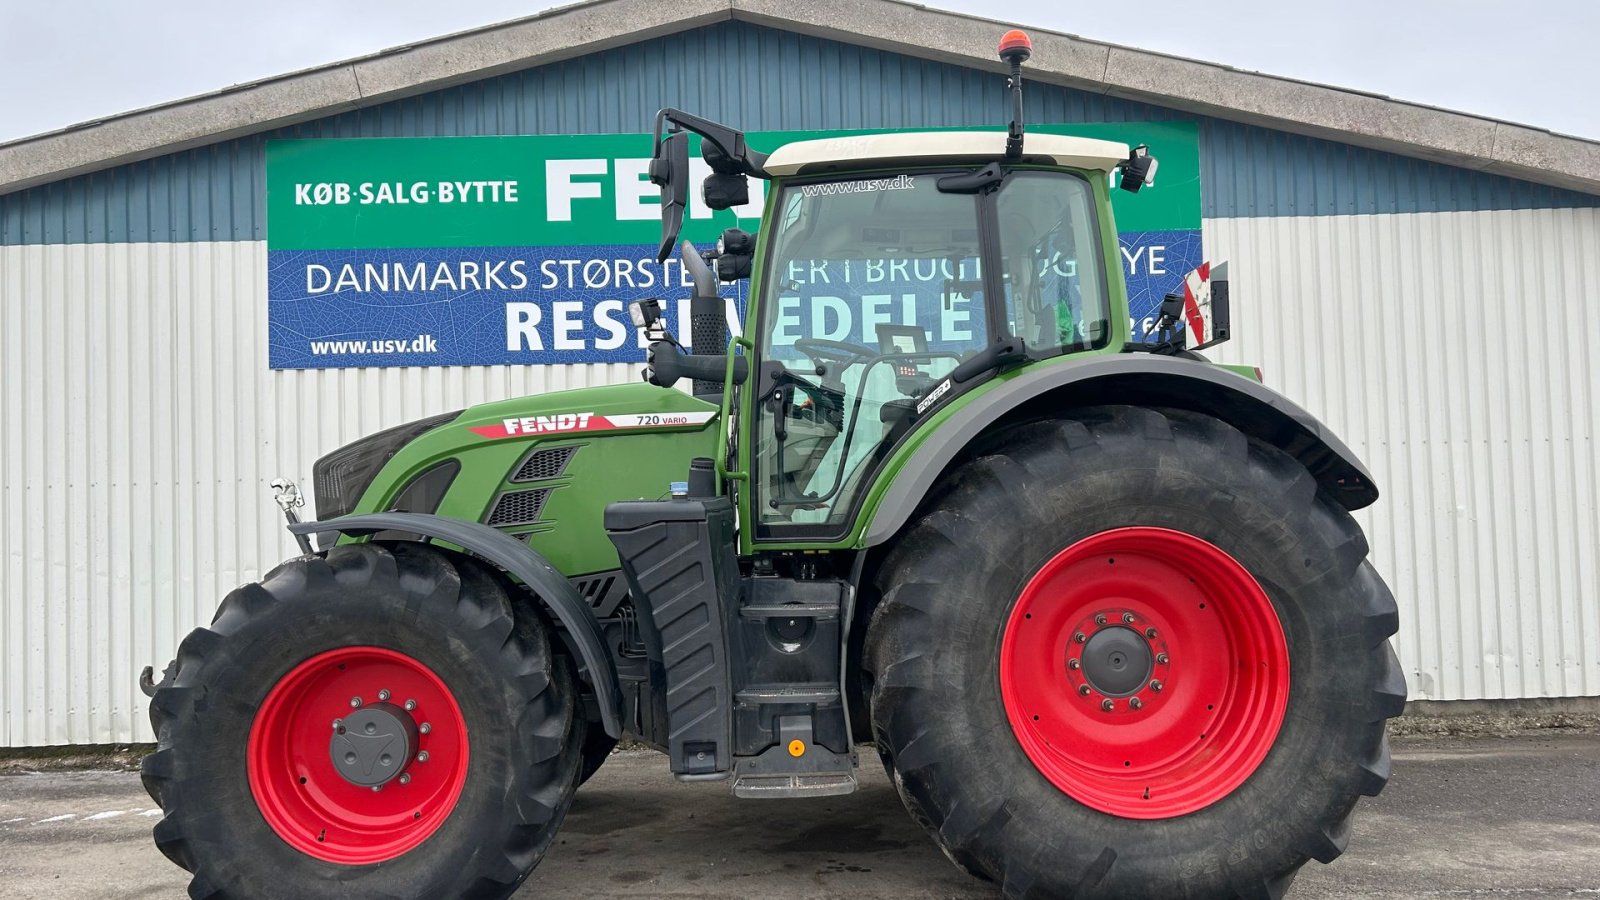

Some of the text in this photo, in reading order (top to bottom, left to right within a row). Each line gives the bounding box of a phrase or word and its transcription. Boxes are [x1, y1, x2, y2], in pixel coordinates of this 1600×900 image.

[801, 174, 915, 198] www.usv.dk
[306, 260, 528, 294] DANMARKS
[1120, 245, 1167, 276] YE
[310, 334, 437, 355] www.usv.dk
[502, 411, 688, 436] FENDT 720 VARIO
